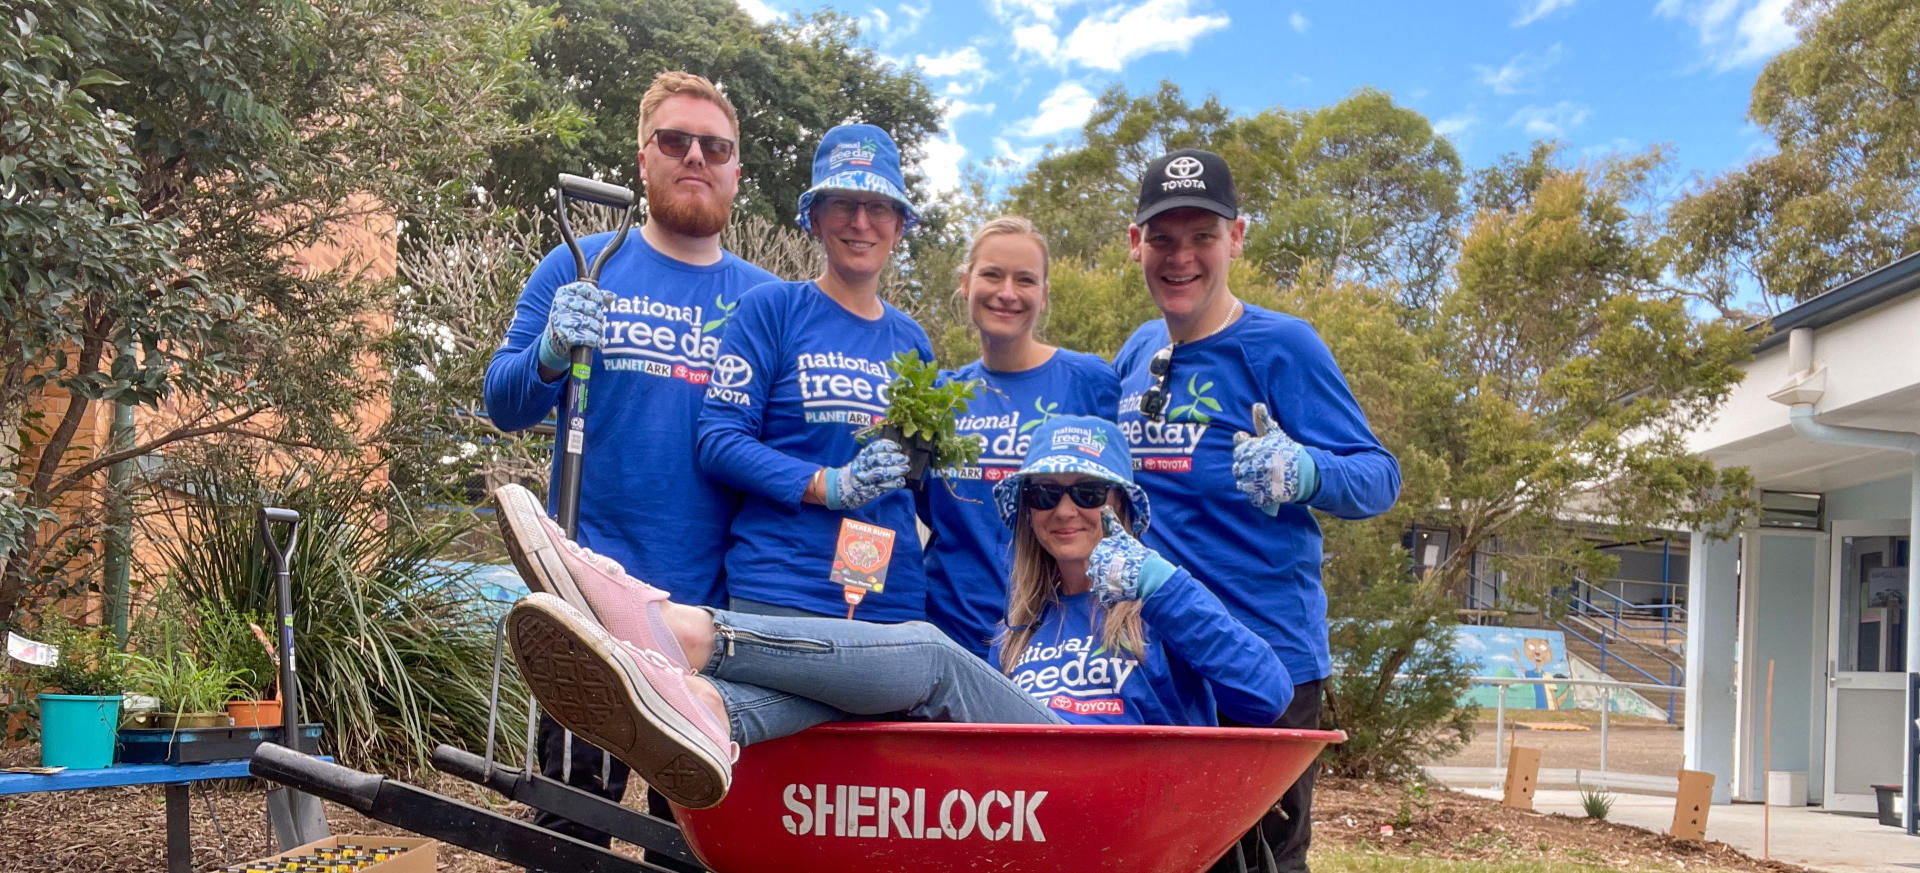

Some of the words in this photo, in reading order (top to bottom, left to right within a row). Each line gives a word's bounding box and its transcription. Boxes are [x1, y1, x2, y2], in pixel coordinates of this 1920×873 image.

[852, 149, 876, 161] day
[1161, 179, 1206, 191] TOYOTA
[601, 316, 677, 351] tree
[681, 327, 721, 360] da
[603, 359, 645, 371] PLANET
[646, 362, 670, 376] ARK
[689, 372, 710, 382] TOY
[798, 352, 892, 379] national
[799, 371, 873, 400] tree
[804, 411, 848, 423] PLANET
[848, 413, 870, 425] ARK
[955, 411, 1020, 430] tional
[1054, 426, 1091, 437] national
[1119, 420, 1143, 445] ee
[1145, 416, 1208, 454] day
[992, 428, 1032, 456] da
[1053, 434, 1081, 444] tree
[1081, 434, 1105, 453] day
[1131, 459, 1142, 469] RK
[1157, 460, 1189, 470] TOYOTA
[960, 470, 980, 480] ARK
[846, 521, 872, 532] TUCKER
[873, 528, 891, 538] BUSH
[1015, 635, 1094, 668] tioal
[1061, 651, 1138, 694] day
[1074, 701, 1121, 713] TOYOTA
[782, 783, 1049, 842] SHERLOCK
